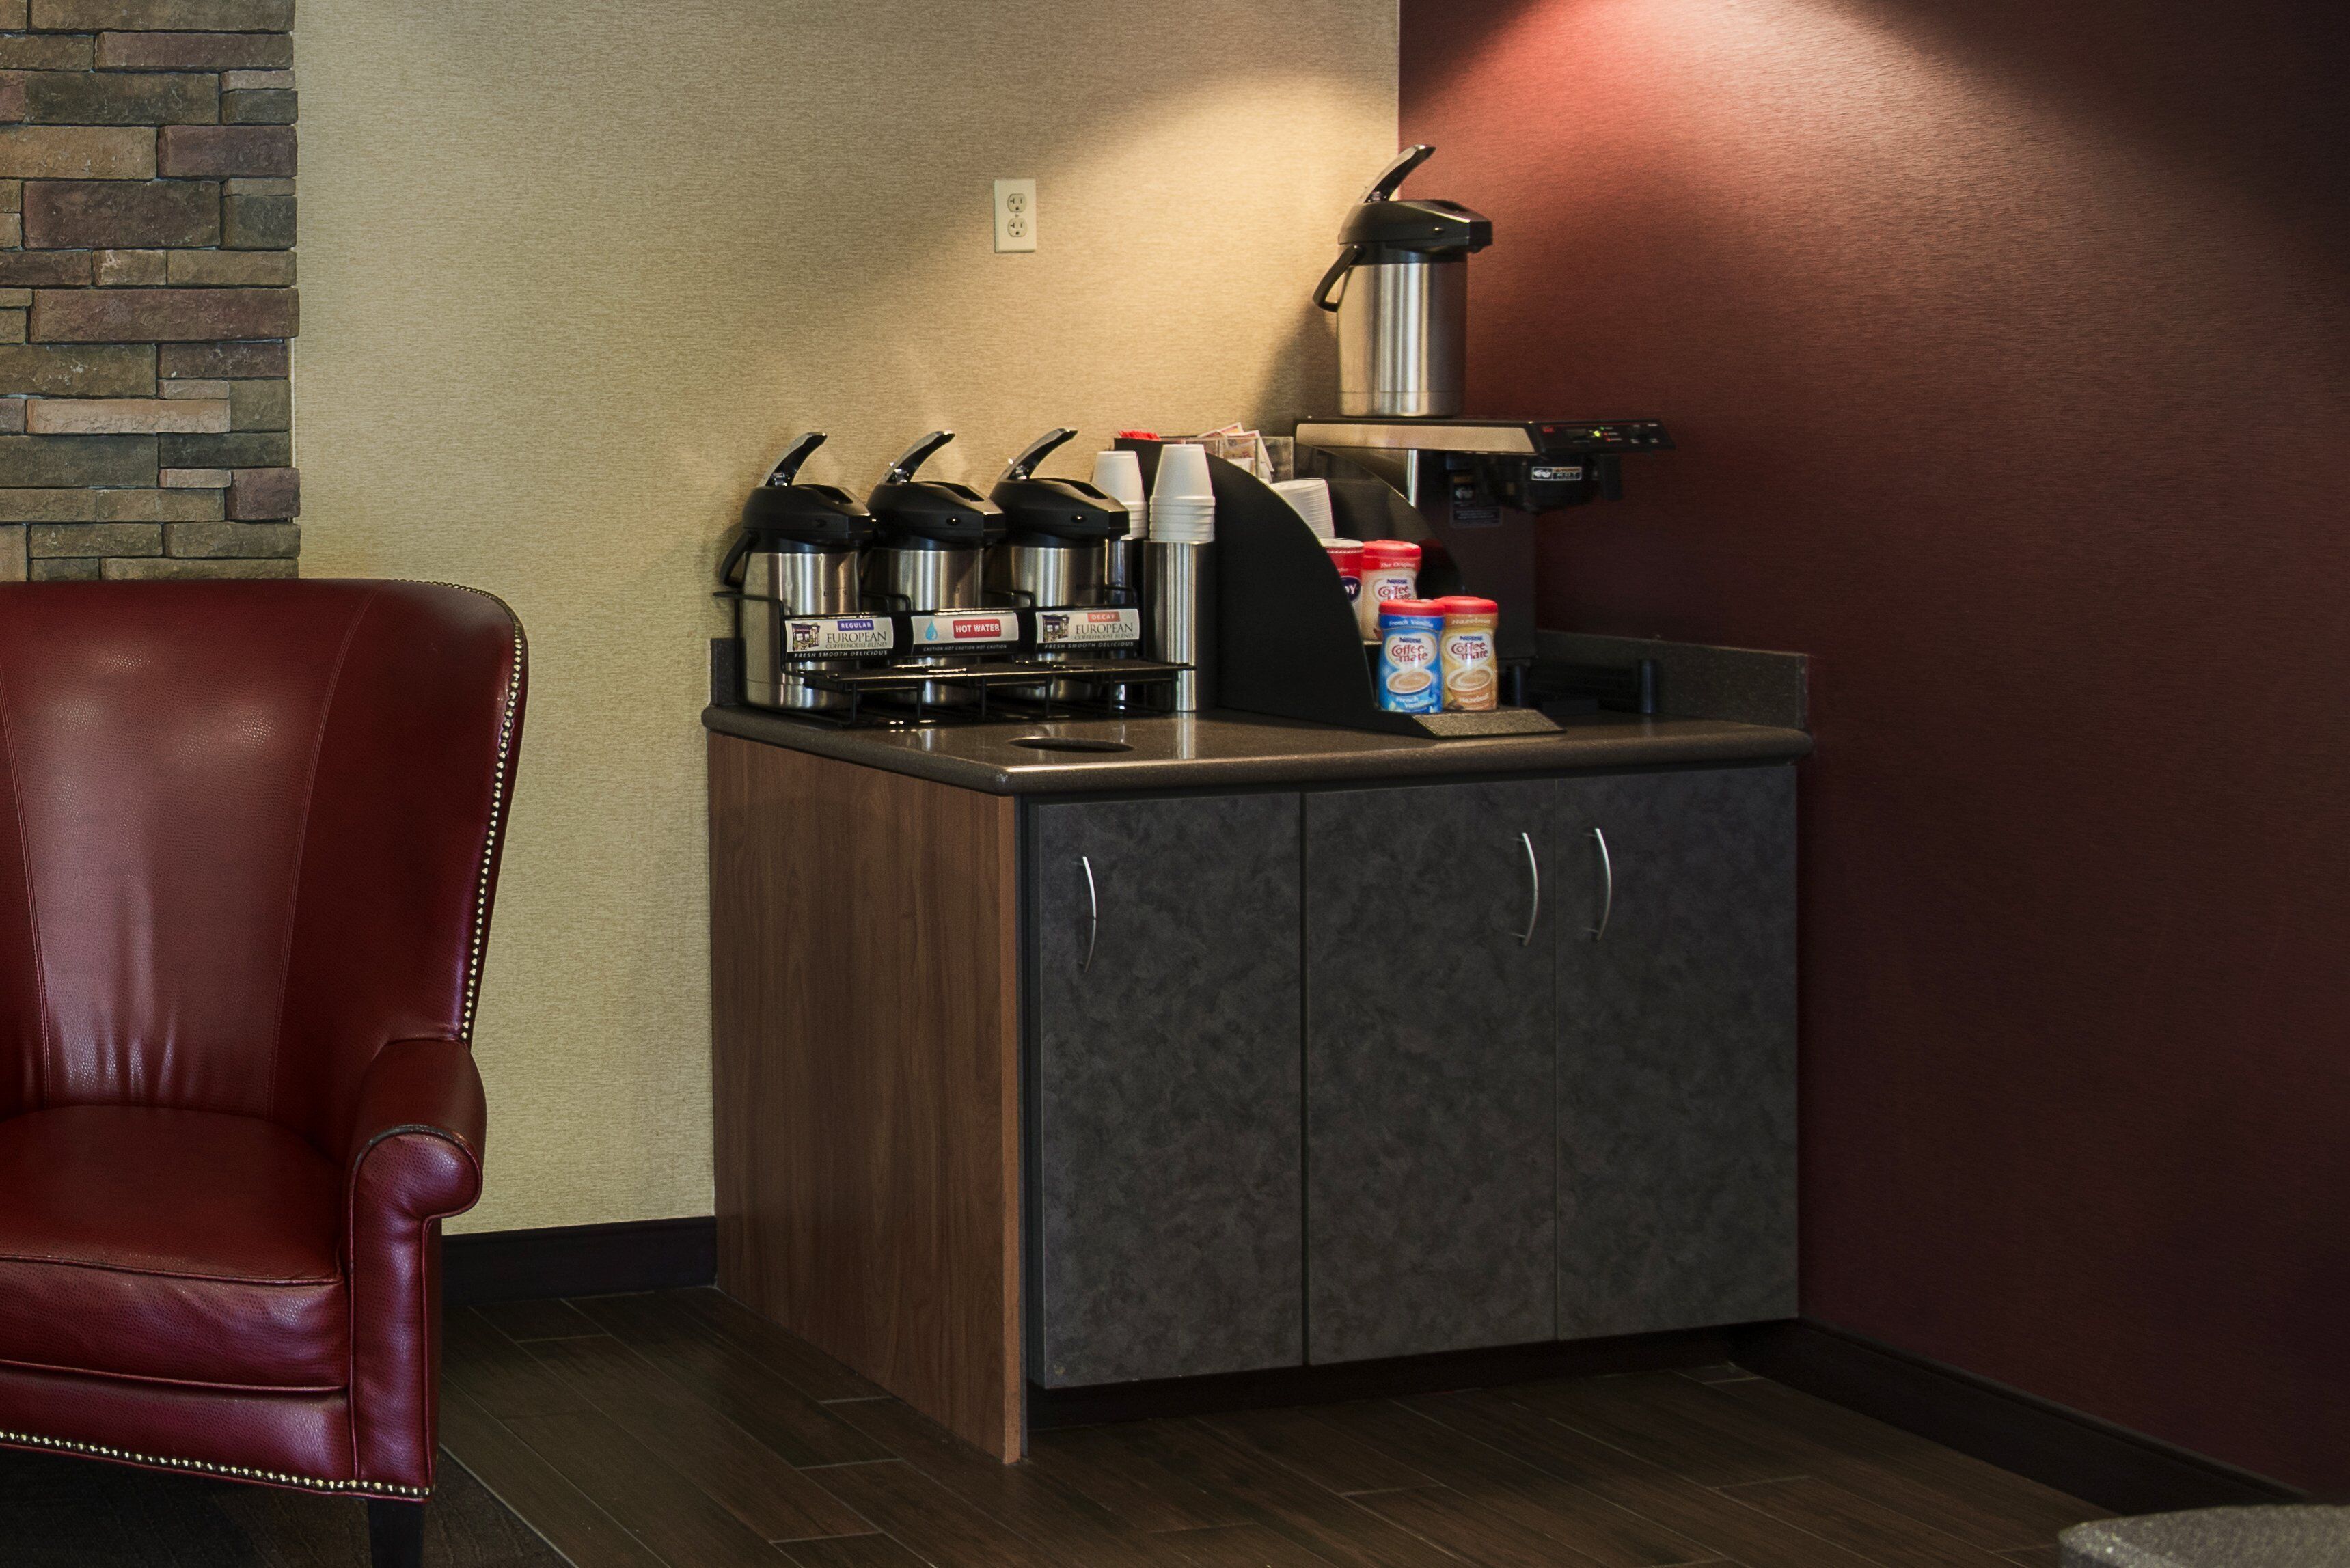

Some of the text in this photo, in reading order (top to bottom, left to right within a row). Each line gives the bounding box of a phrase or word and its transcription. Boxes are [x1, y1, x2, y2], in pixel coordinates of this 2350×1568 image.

[1378, 585, 1409, 598] Cofee
[955, 623, 1000, 633] HOT WATER
[1076, 622, 1133, 635] EUROPEAN
[827, 631, 887, 644] EUROPEAN
